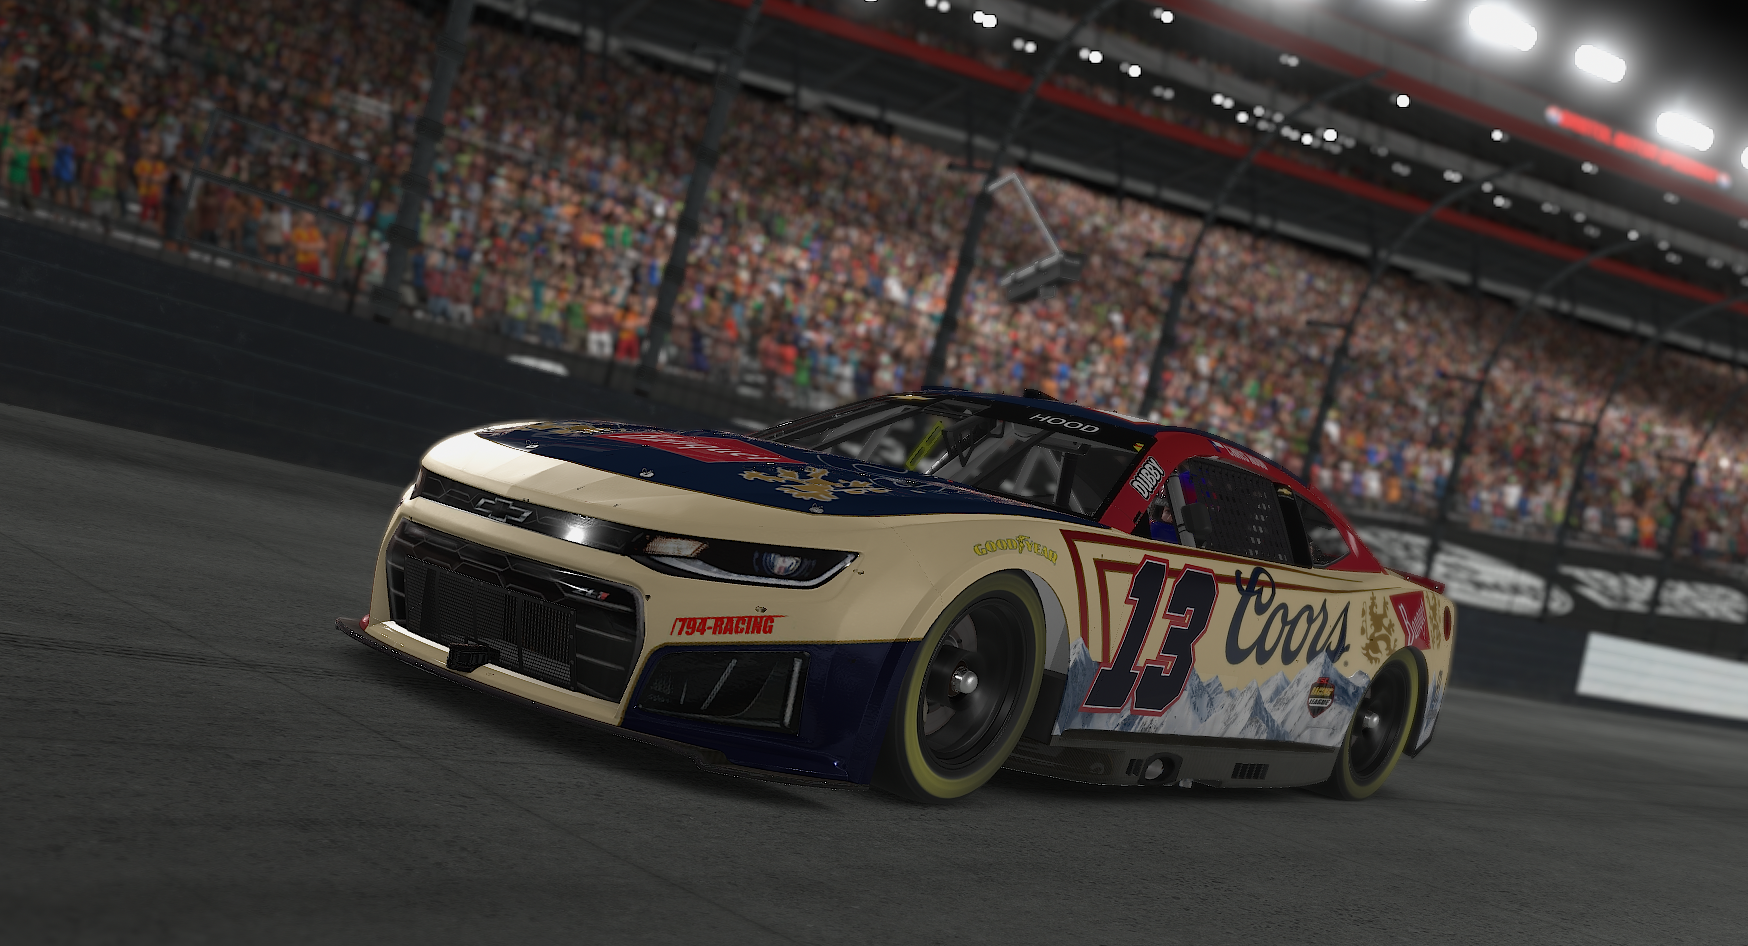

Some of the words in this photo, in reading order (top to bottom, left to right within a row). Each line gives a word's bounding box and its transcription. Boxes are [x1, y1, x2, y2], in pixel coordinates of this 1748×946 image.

[1030, 413, 1100, 433] HOOD
[1130, 456, 1166, 501] DUBBY
[1078, 554, 1219, 717] 13
[1225, 567, 1350, 666] Coors
